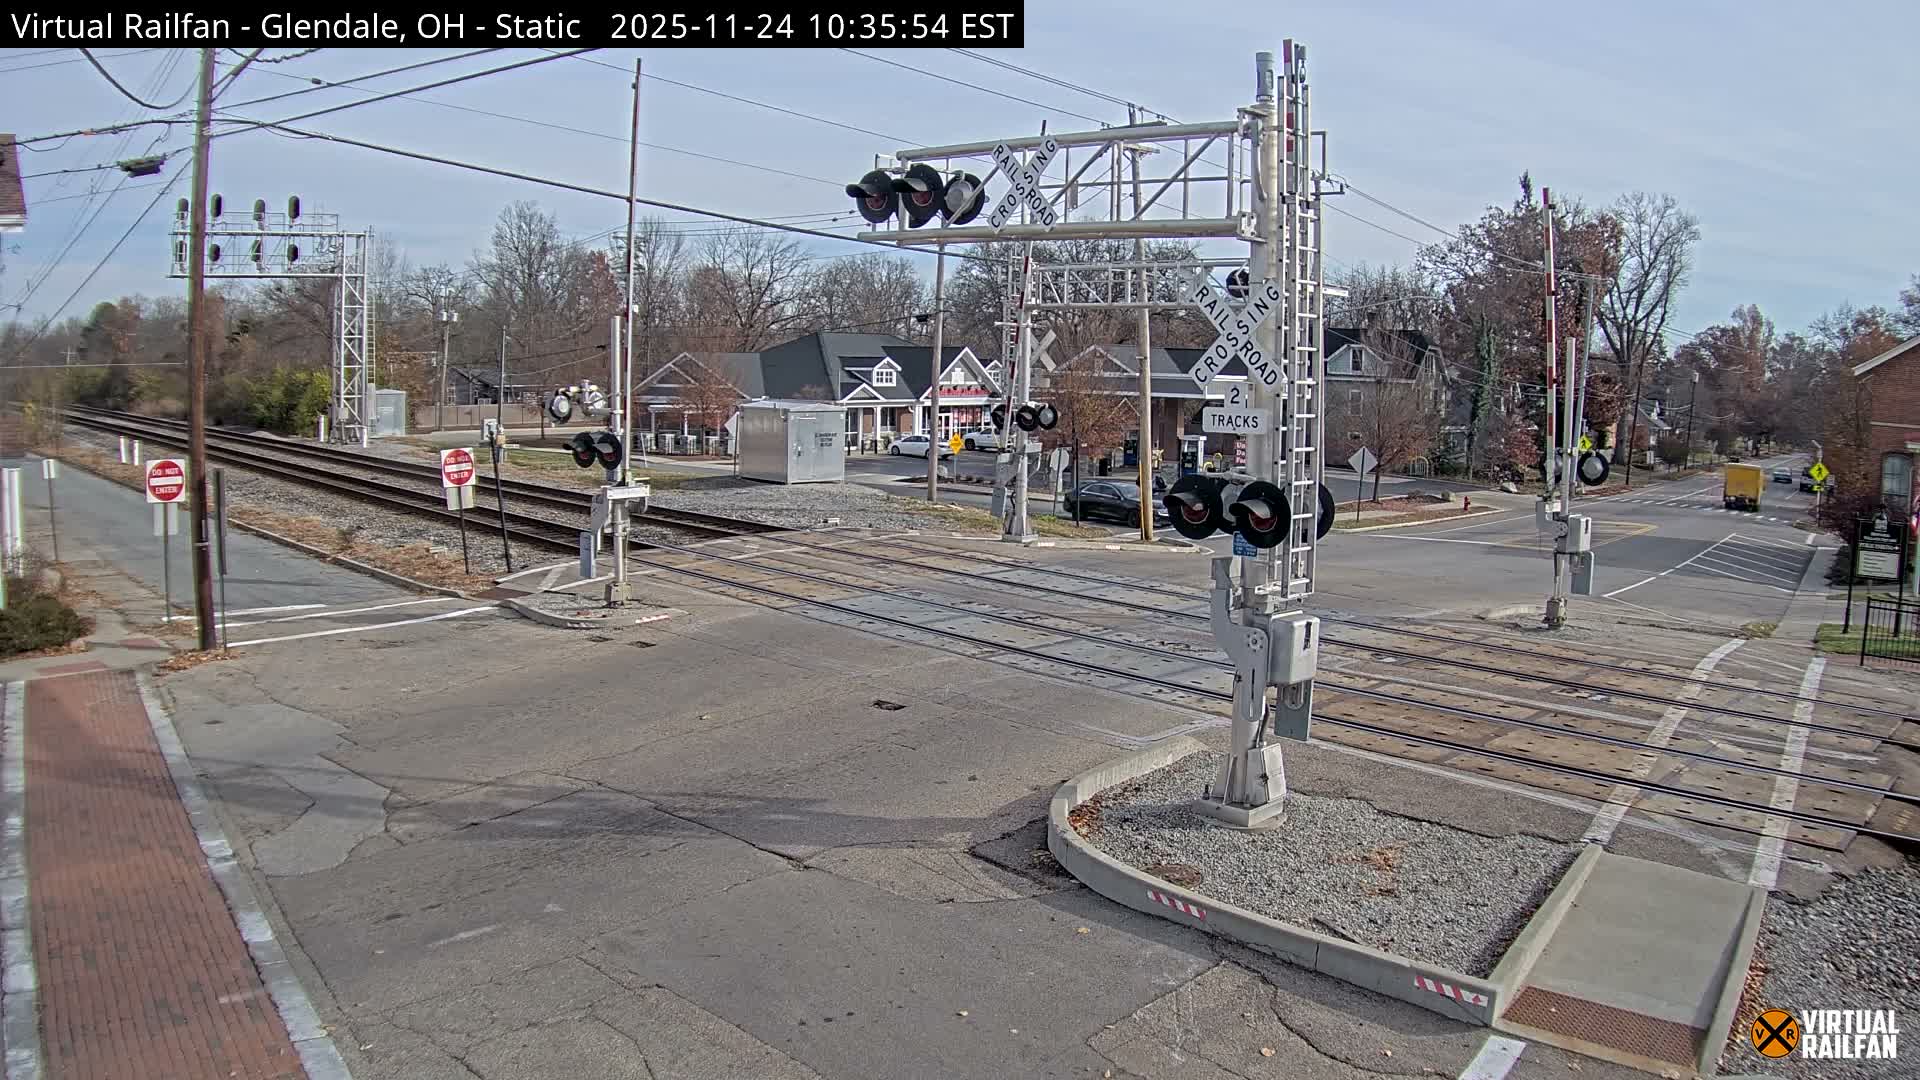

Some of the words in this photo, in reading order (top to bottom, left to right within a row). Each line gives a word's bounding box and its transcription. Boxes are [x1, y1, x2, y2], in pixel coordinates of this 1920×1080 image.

[991, 140, 1055, 228] CROSSING
[1194, 286, 1280, 383] CROSSING
[1230, 387, 1240, 404] 2
[1211, 414, 1259, 429] TRACKS
[446, 456, 455, 464] DO
[457, 454, 470, 462] NOT
[152, 468, 162, 476] DO
[165, 467, 179, 475] NOT
[450, 471, 469, 480] ENTER
[155, 486, 177, 494] ENTER
